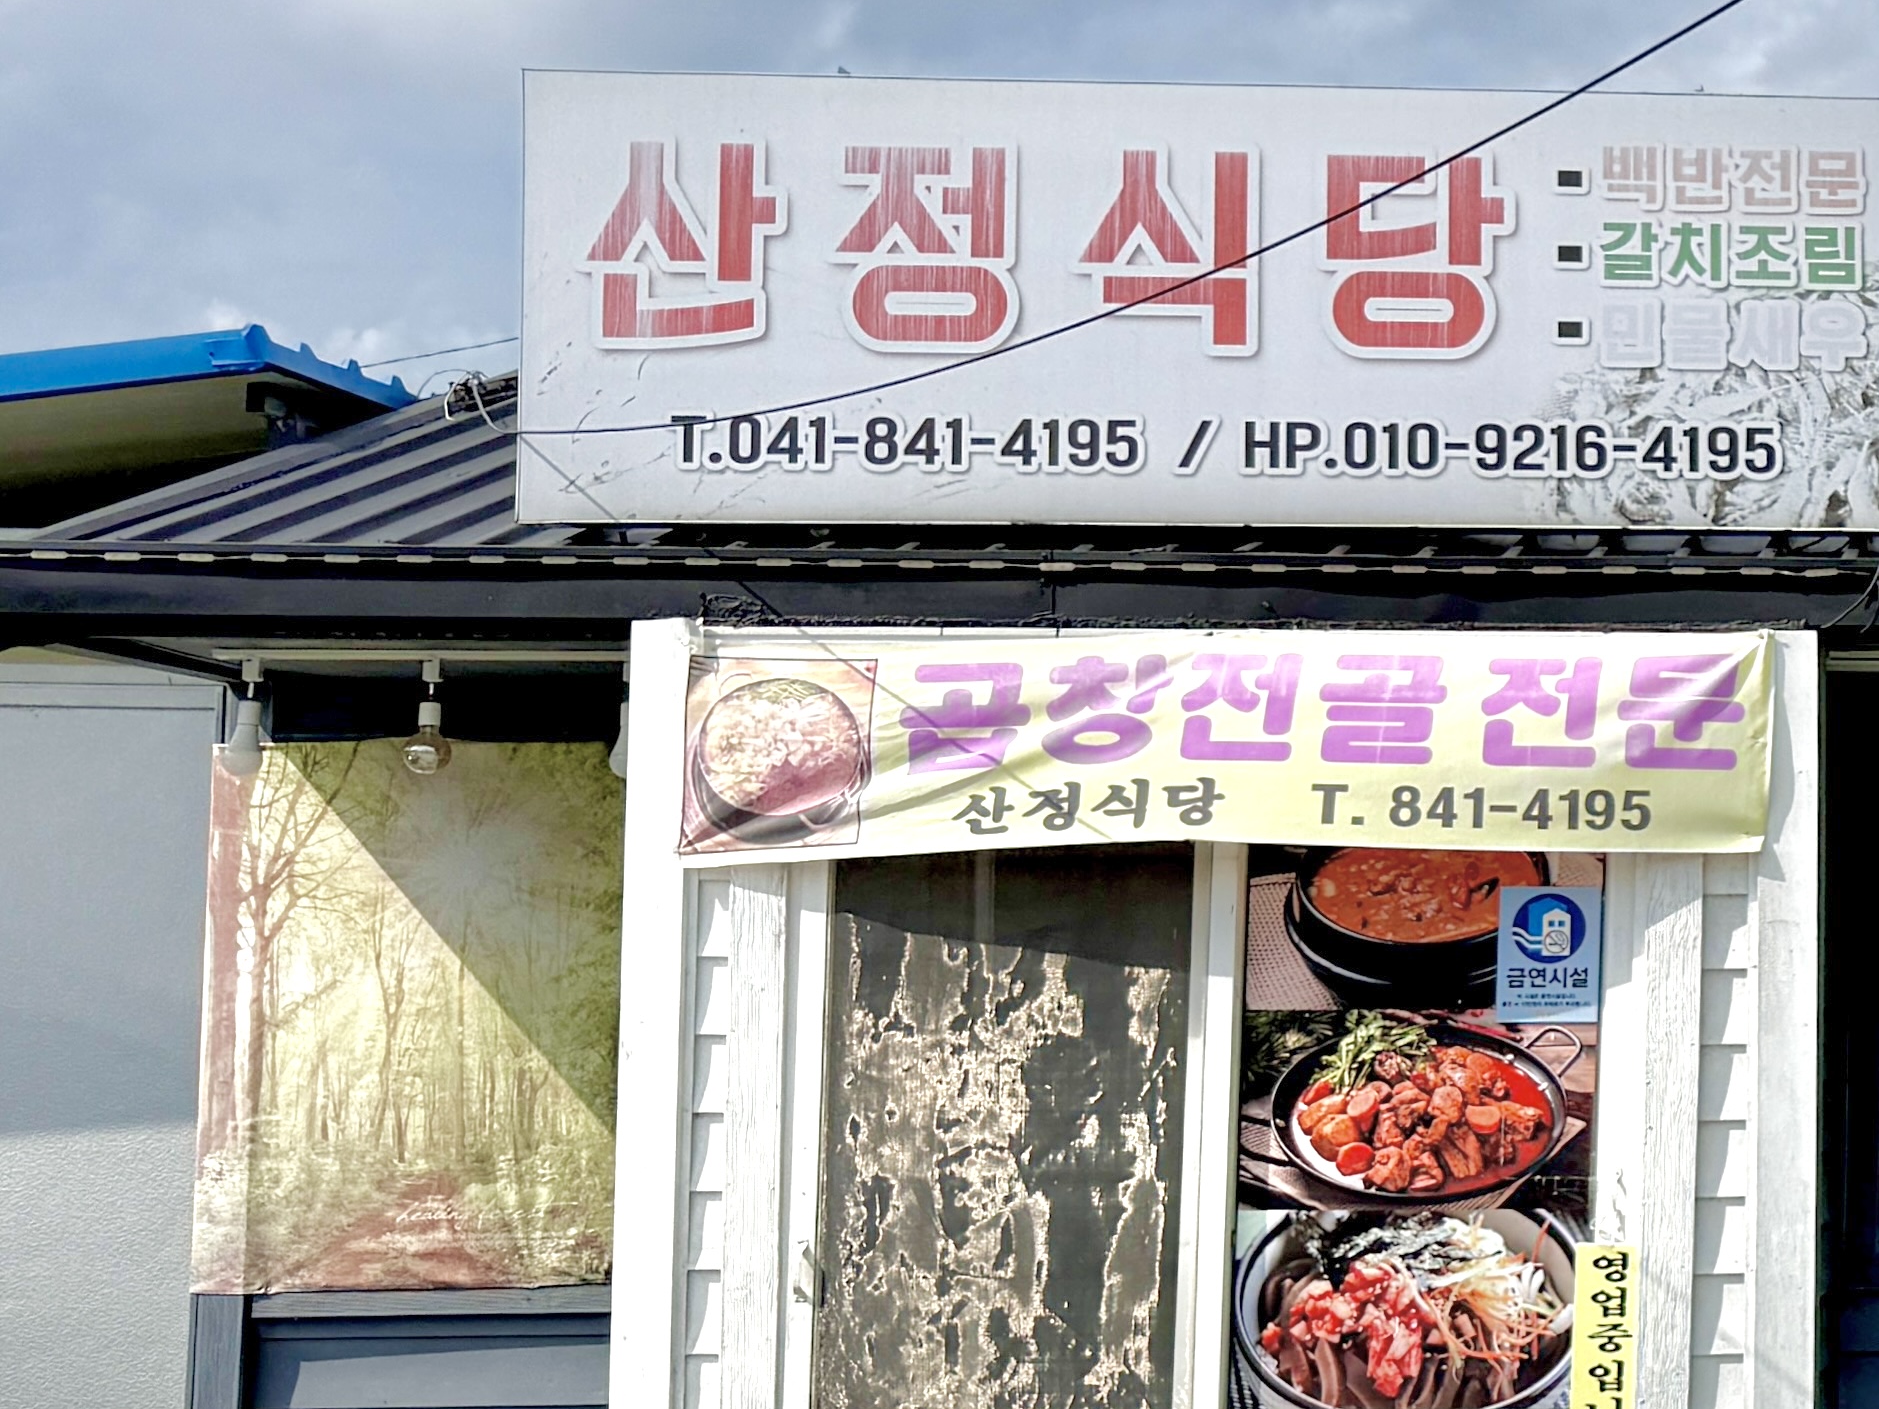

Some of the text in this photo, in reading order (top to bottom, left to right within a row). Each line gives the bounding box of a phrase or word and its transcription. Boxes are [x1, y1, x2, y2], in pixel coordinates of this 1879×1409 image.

[1601, 145, 1861, 209] 백반전문
[584, 139, 1507, 350] 산정식당
[1599, 220, 1859, 286] 갈치조림
[1601, 297, 1867, 370] 민물새우
[671, 414, 1139, 469] T.041-841-4195
[1243, 419, 1778, 474] HP.010-9216-4195
[898, 653, 1746, 776] 곱창전골 전문
[951, 776, 1652, 836] 산정식당 T. 841-4195
[1506, 967, 1589, 989] 금연시설
